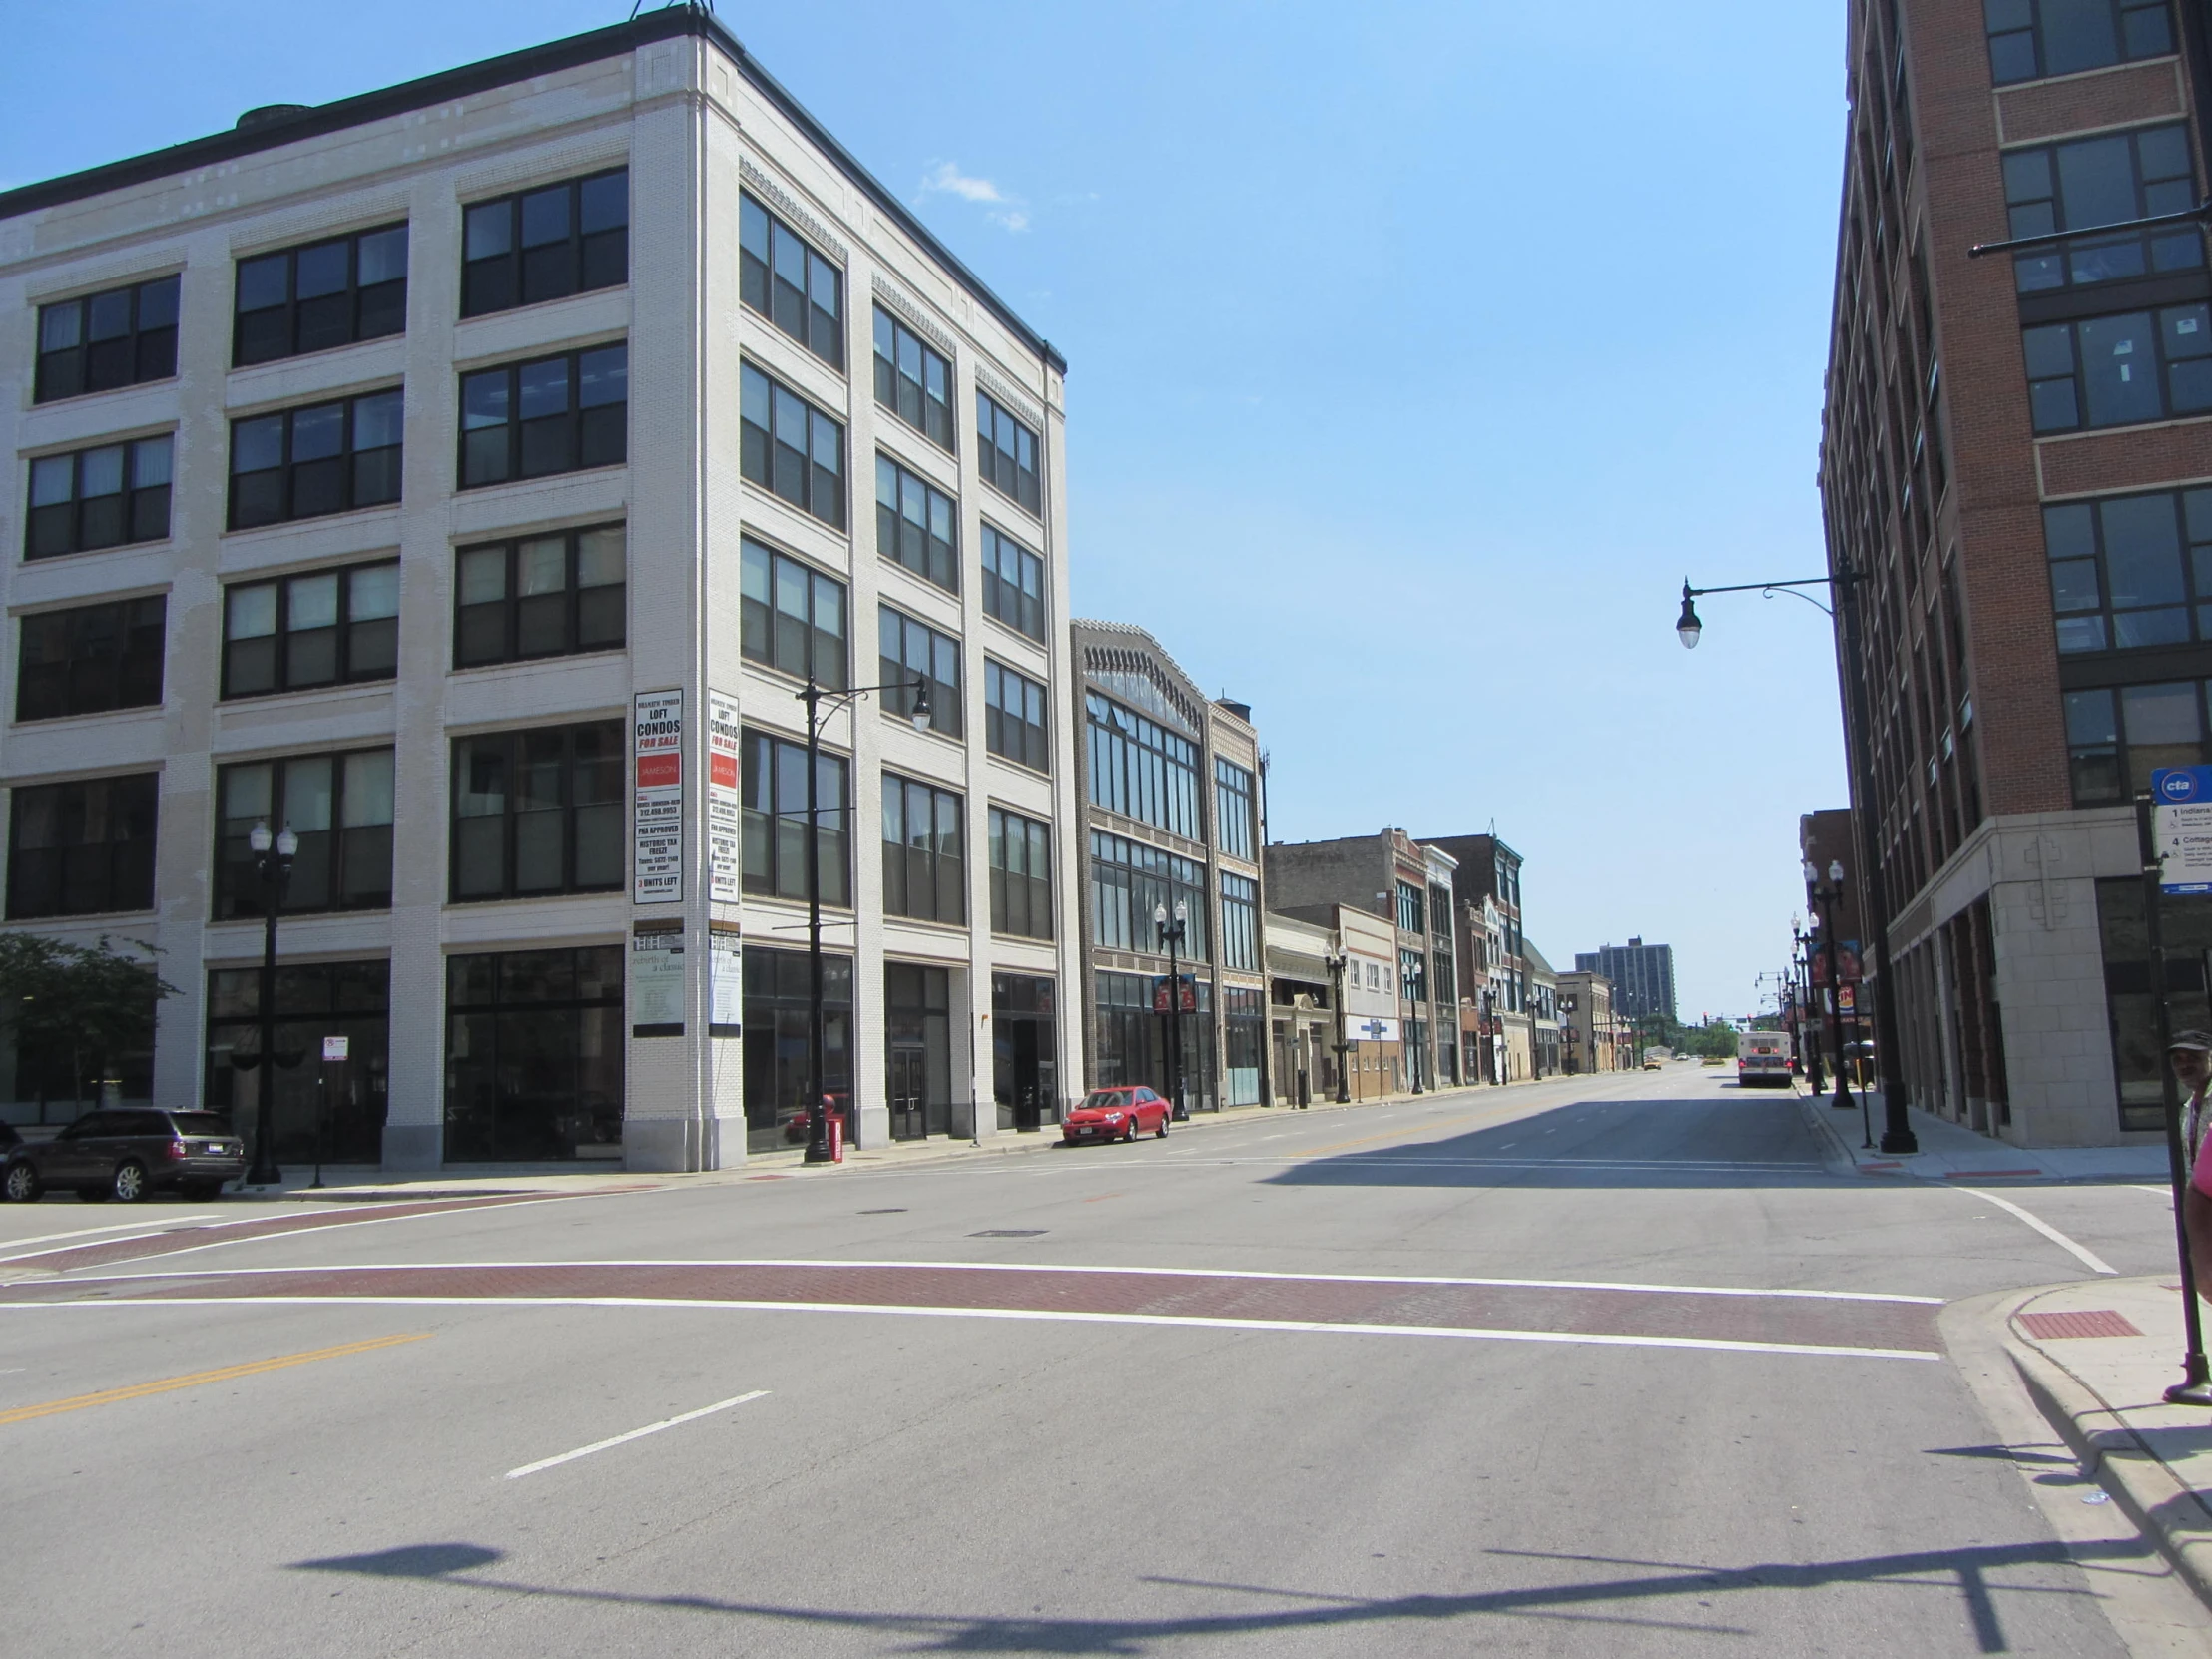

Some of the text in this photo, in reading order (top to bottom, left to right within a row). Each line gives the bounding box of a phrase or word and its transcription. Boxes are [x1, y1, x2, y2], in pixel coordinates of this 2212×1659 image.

[650, 709, 667, 720] LOFT
[719, 710, 730, 721] LOFT
[637, 720, 680, 737] CONDOS
[711, 720, 737, 738] CONDOS
[639, 735, 679, 749] FOR SALE
[712, 736, 737, 751] FOR SALE
[2167, 781, 2190, 791] cta
[650, 825, 679, 834] APPROVED
[643, 878, 663, 887] UNITS
[664, 876, 678, 886] LEFT
